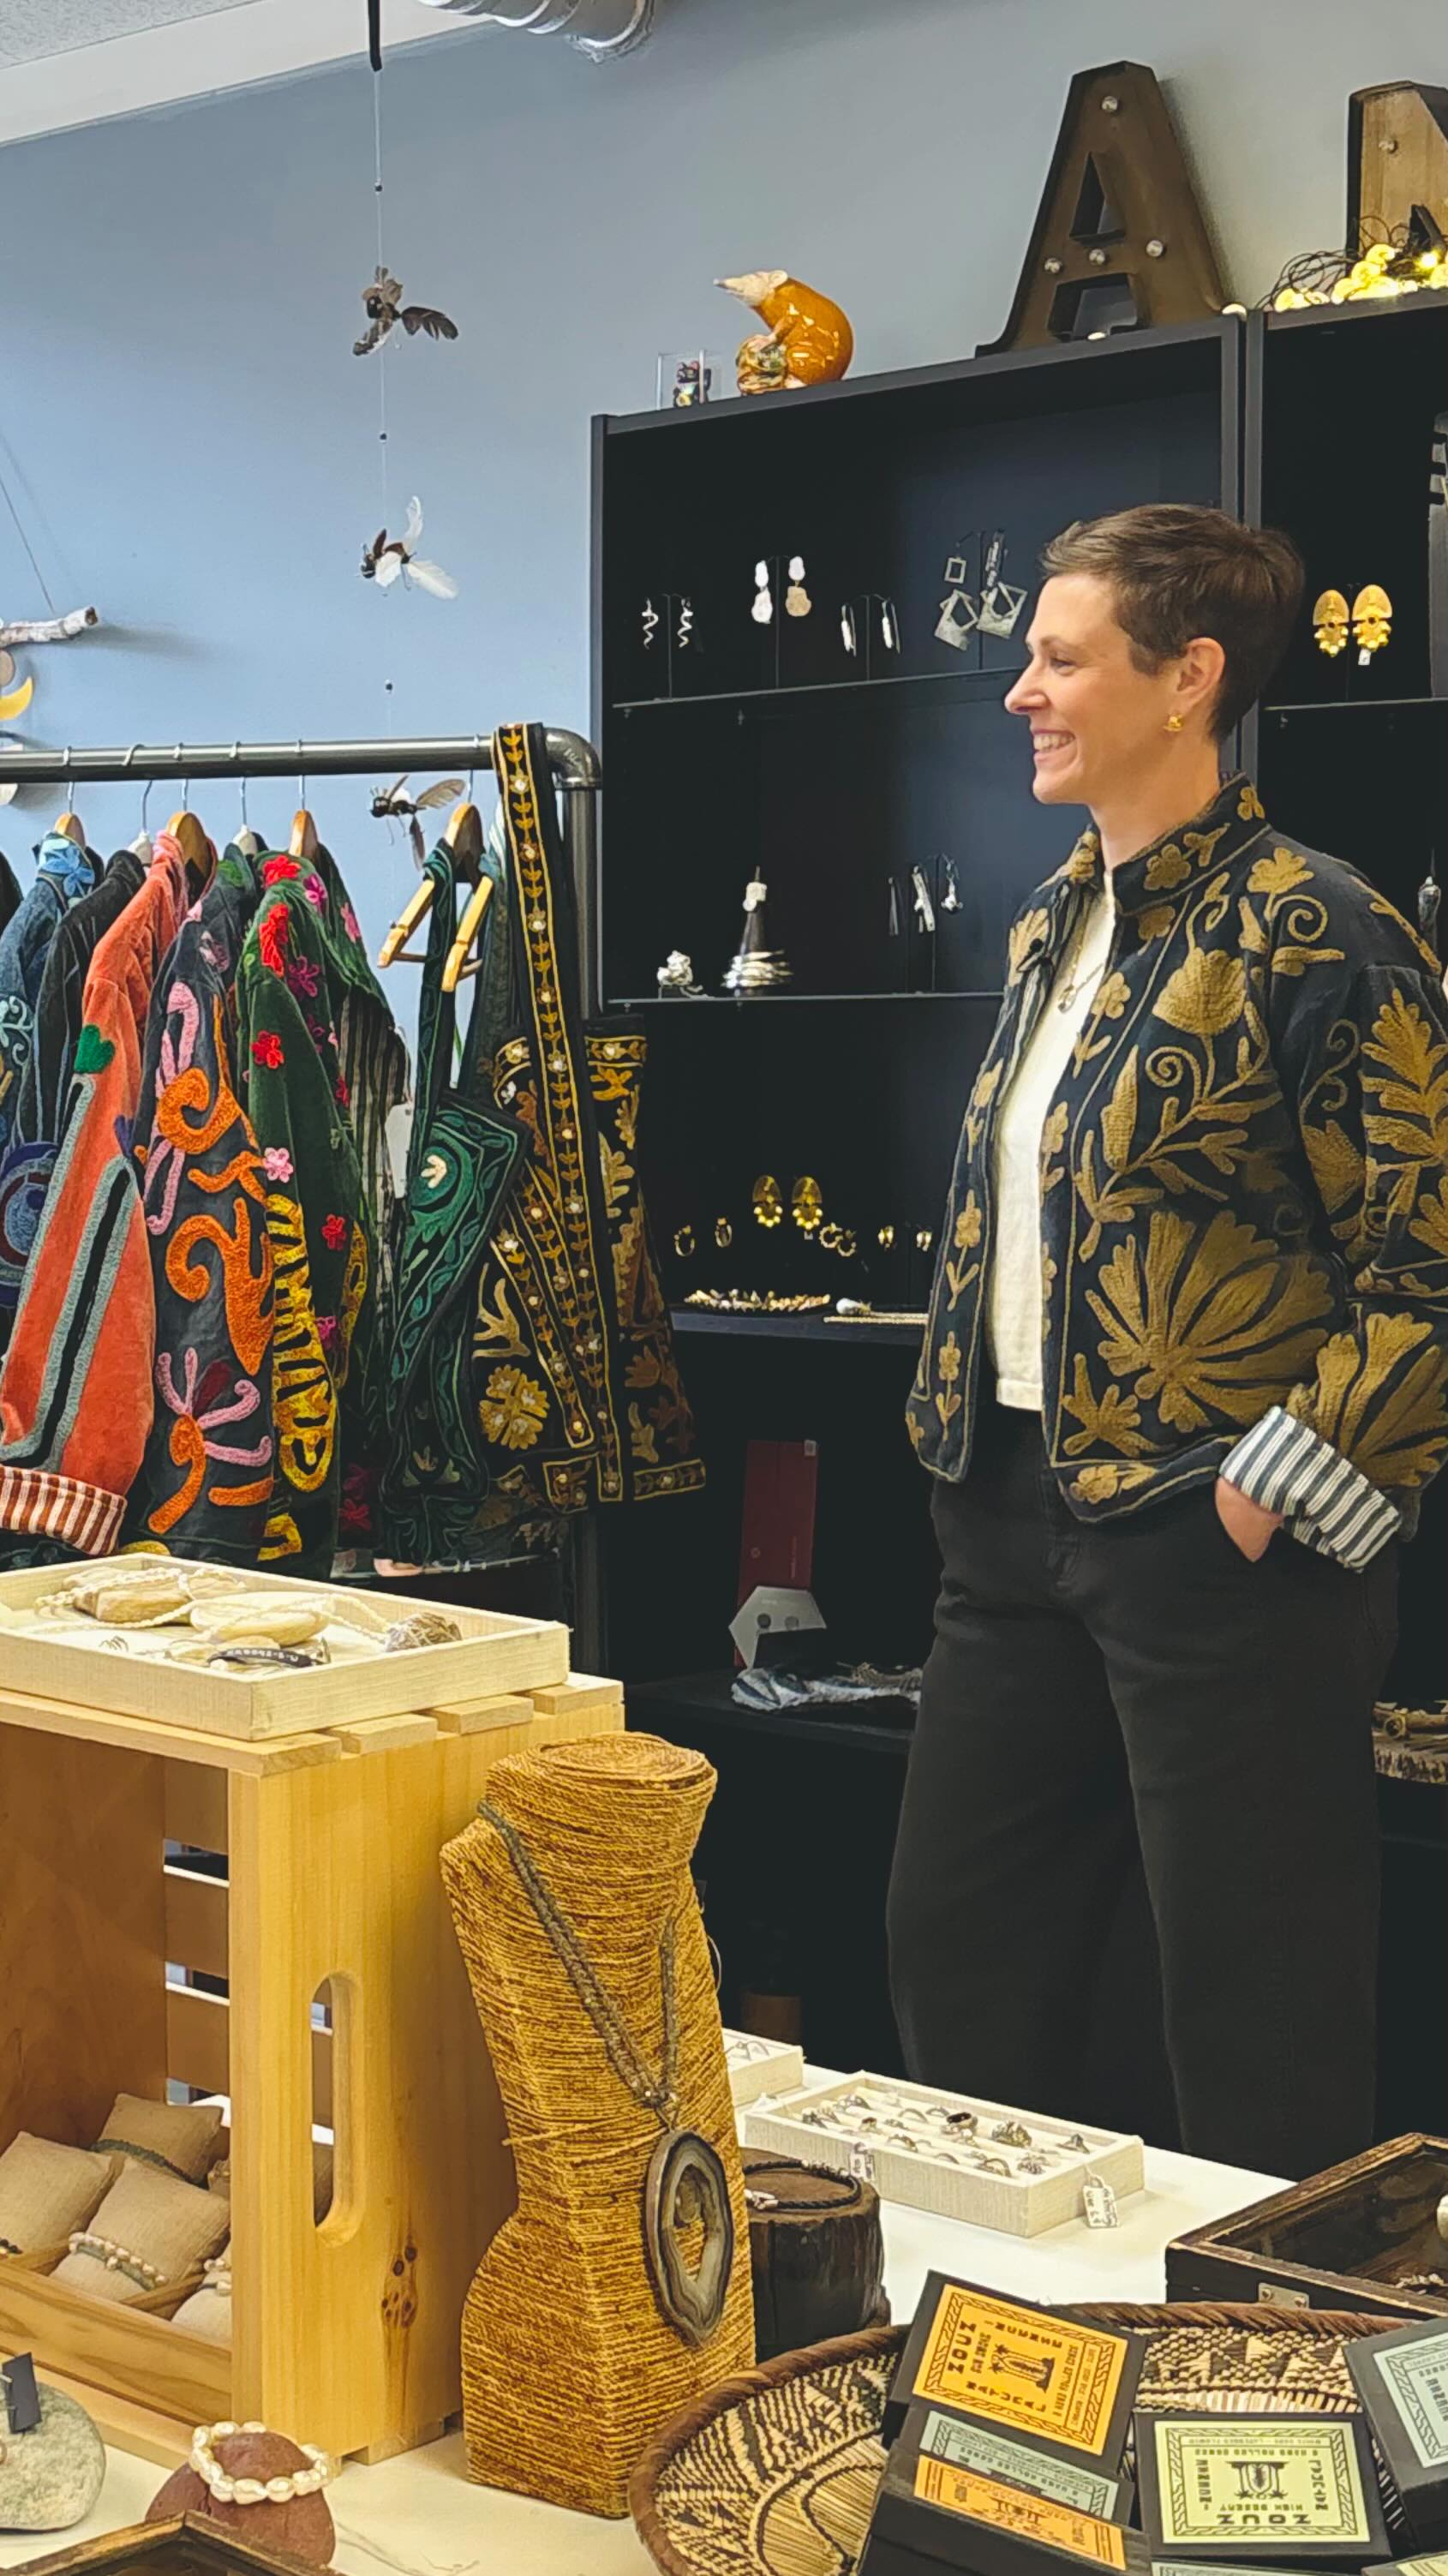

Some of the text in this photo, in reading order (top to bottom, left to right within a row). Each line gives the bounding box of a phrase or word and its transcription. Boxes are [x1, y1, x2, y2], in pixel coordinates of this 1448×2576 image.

[948, 2321, 977, 2375] ZOUZ
[984, 2321, 1062, 2348] INCENSE
[966, 2381, 1045, 2412] NATURAL
[1215, 2513, 1310, 2524] ZOUZ
